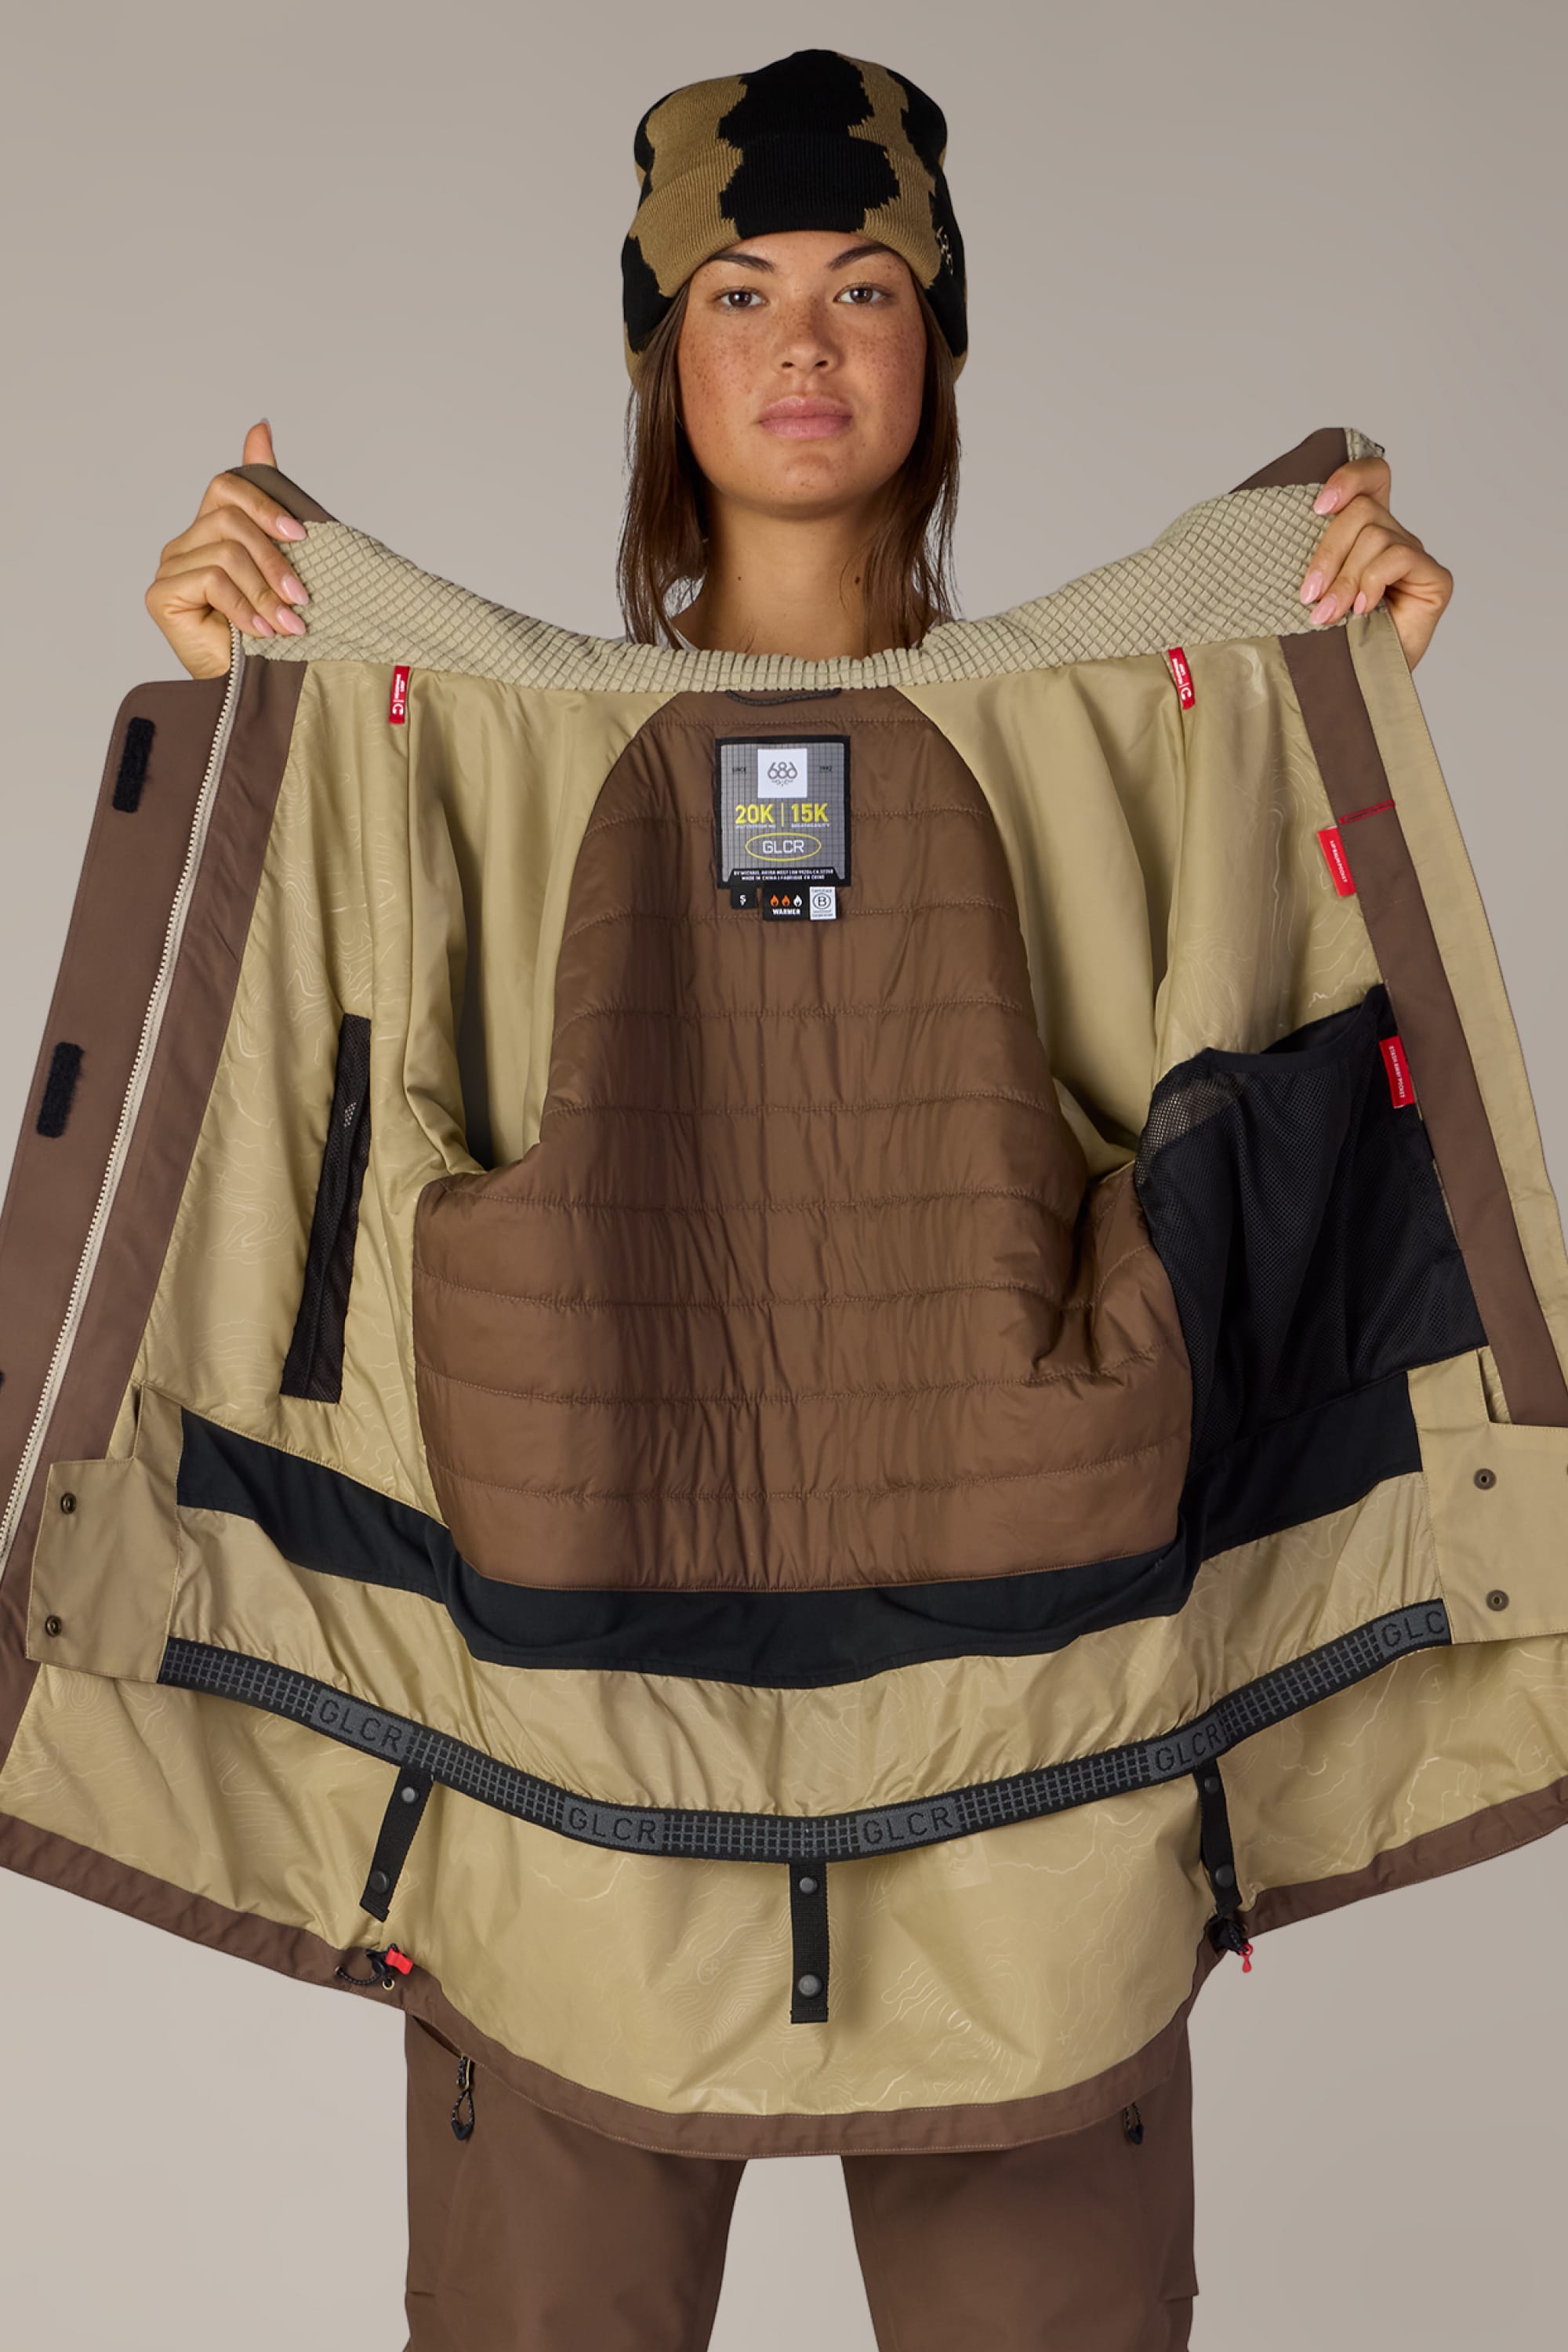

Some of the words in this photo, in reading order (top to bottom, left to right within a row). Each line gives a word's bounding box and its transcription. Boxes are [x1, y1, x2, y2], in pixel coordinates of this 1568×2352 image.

[735, 803, 775, 824] 20K
[791, 803, 829, 822] 15K
[762, 840, 804, 854] GLCR
[318, 1699, 402, 1755] GLCR
[1156, 1723, 1221, 1772] GLCR
[568, 1807, 656, 1844] GLCR
[862, 1807, 954, 1844] GLCR
